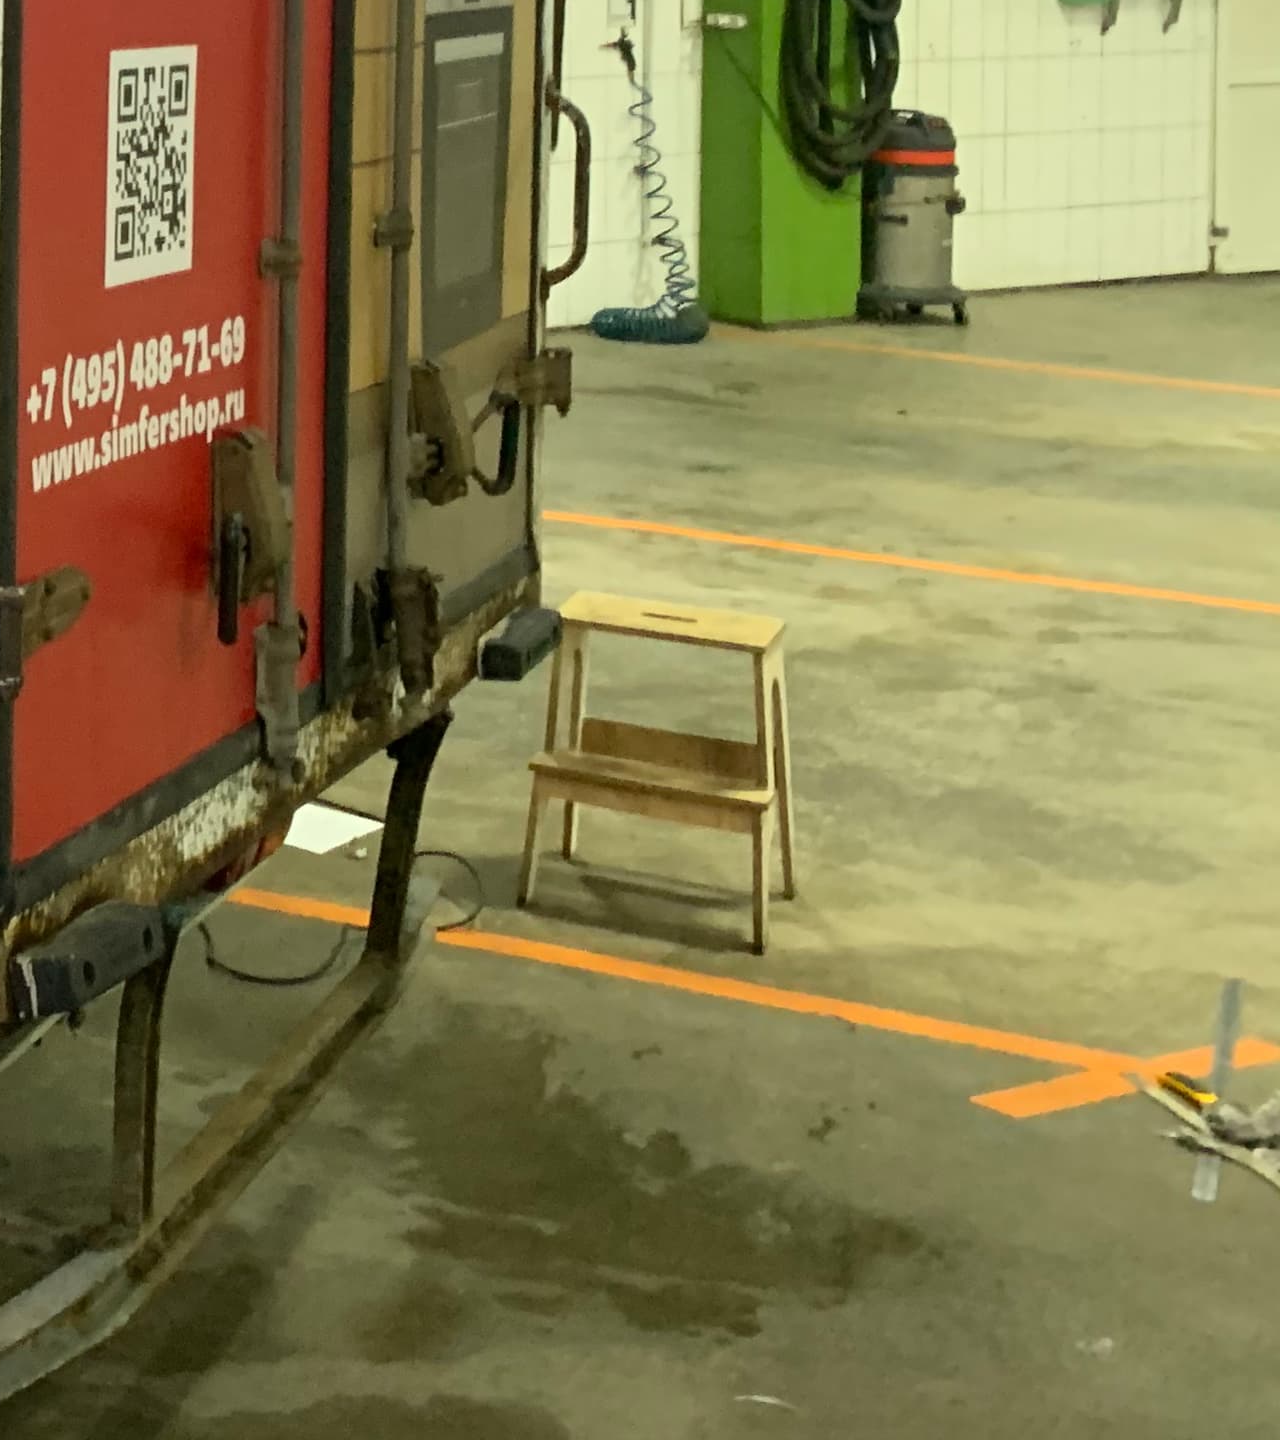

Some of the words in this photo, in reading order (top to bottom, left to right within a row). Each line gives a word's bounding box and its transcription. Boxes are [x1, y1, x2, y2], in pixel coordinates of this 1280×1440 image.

[25, 366, 57, 425] +7
[62, 338, 126, 430] (495)
[129, 315, 246, 392] 488-71-69
[31, 388, 246, 494] www.simfershop.ru
